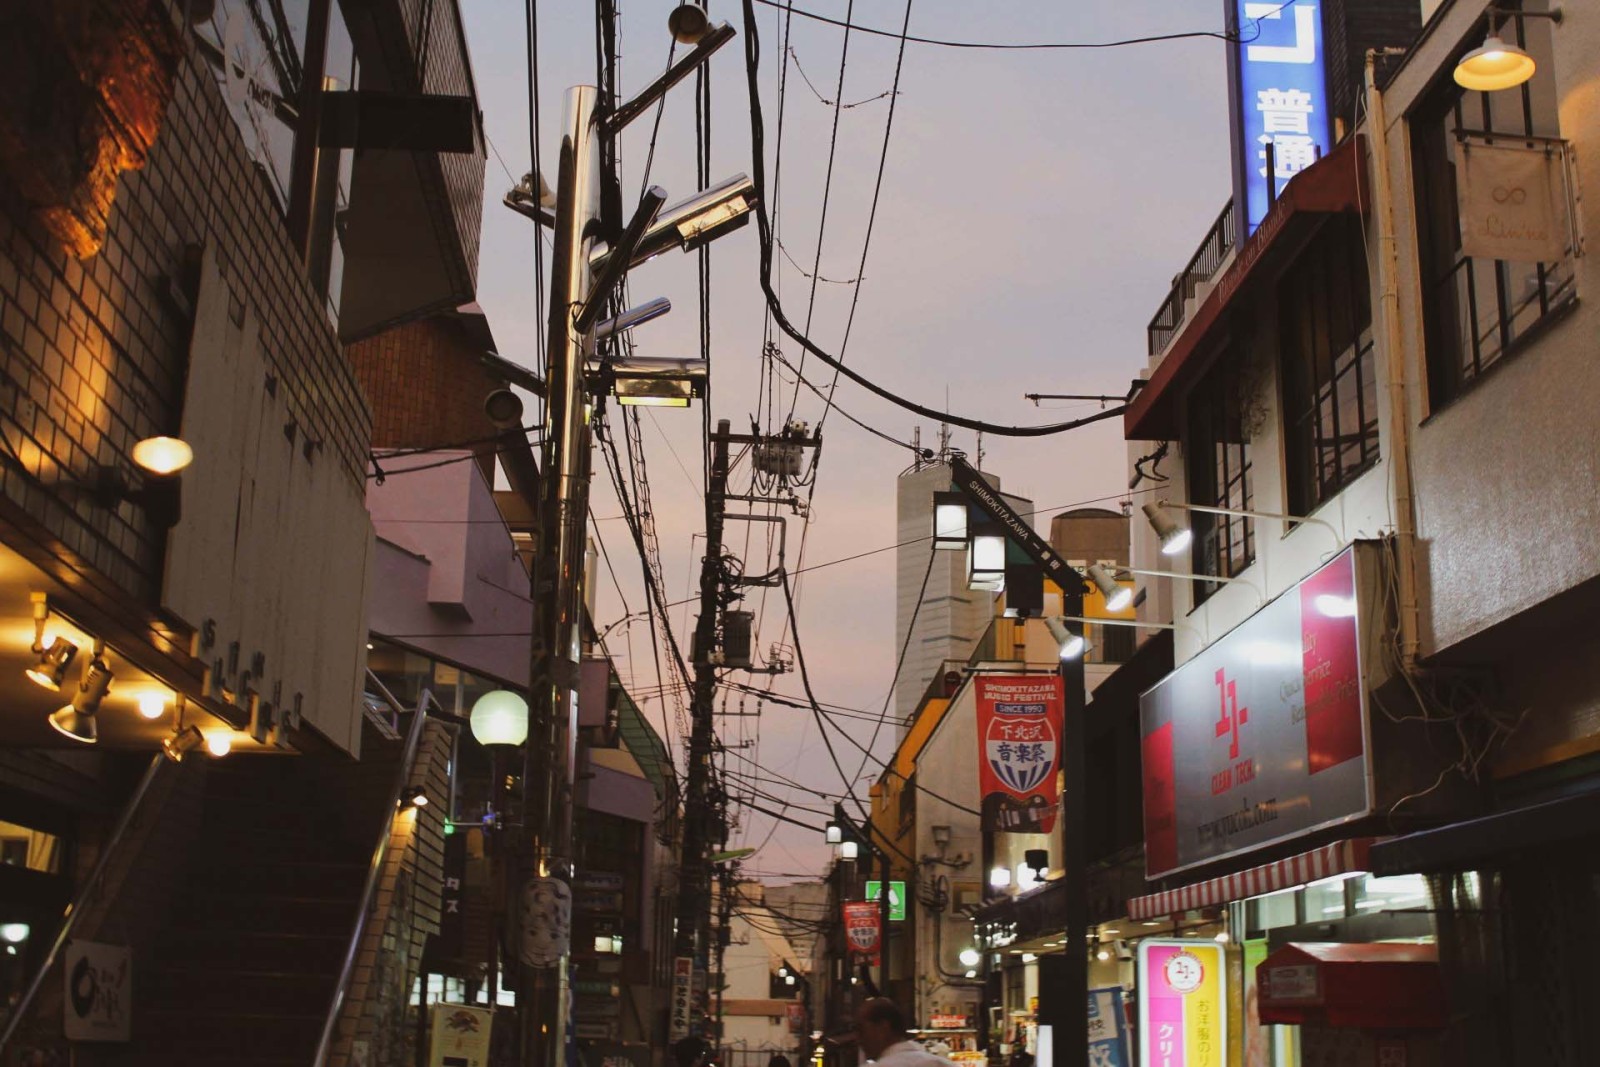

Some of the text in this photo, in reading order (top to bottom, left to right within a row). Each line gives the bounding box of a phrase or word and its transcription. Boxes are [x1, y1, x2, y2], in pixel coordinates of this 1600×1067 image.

[1256, 87, 1314, 192] 普通
[969, 480, 1029, 541] SHIMOKITAZAWA
[984, 683, 1056, 692] SHIMOKITAZAWA
[984, 692, 1057, 702] MUSIC FESTIVAL
[999, 704, 1023, 713] SINCE
[1000, 725, 1044, 740] 下北沢
[997, 742, 1046, 763] 音楽祭
